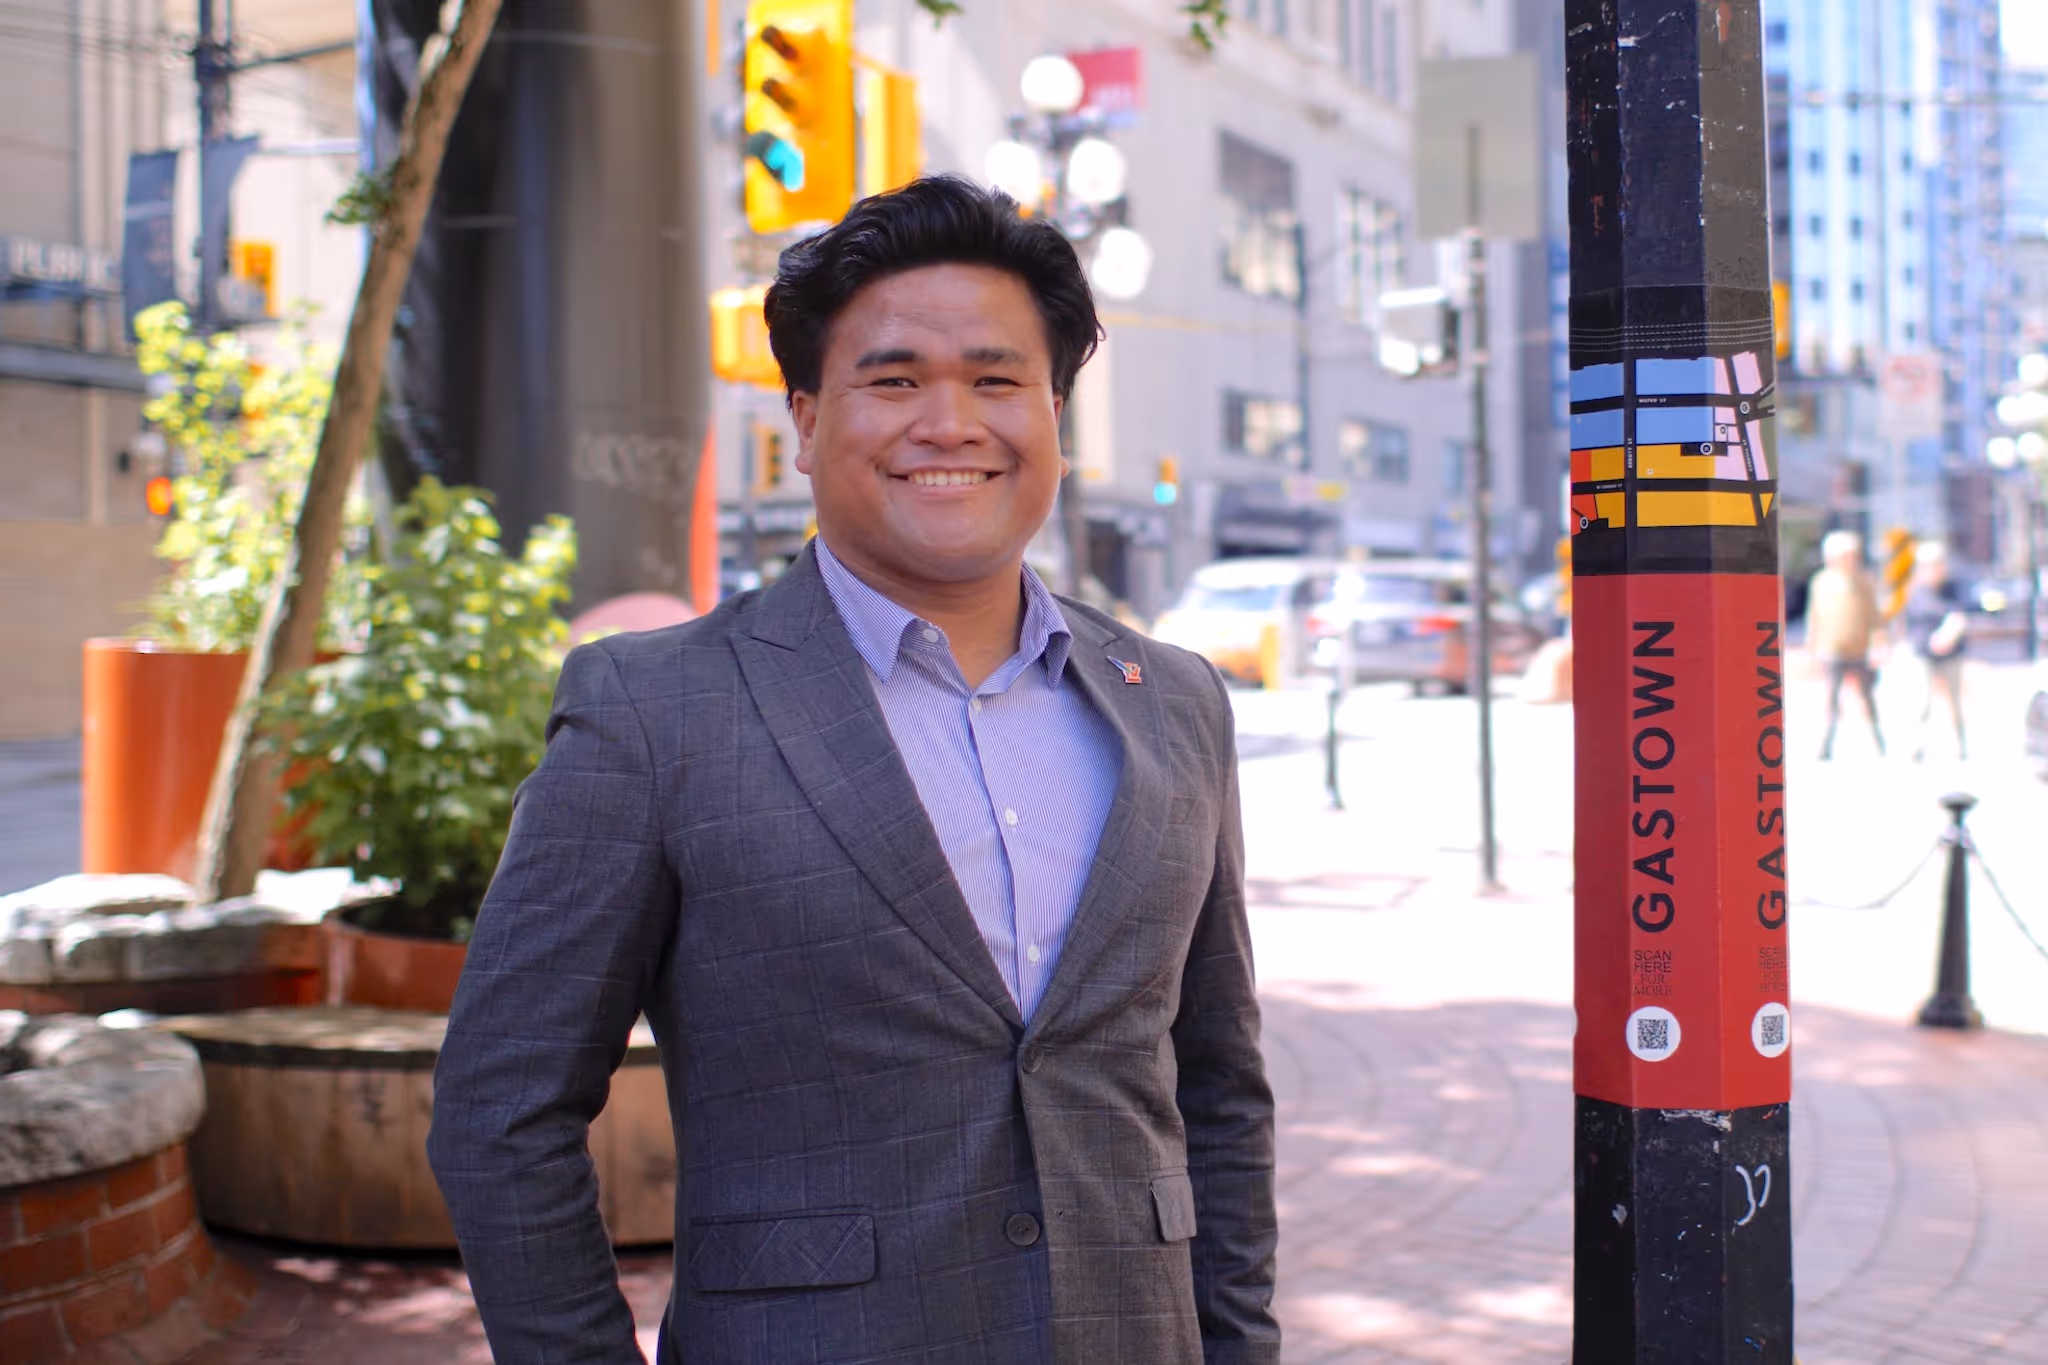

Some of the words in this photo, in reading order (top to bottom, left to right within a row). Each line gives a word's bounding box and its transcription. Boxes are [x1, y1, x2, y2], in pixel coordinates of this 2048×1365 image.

[1632, 621, 1676, 934] GASTOWN
[1756, 620, 1787, 930] GASTOWN
[1634, 949, 1672, 961] SCAN
[1634, 961, 1672, 973] HERE
[1640, 973, 1665, 985] FOR
[1633, 984, 1673, 997] MORE
